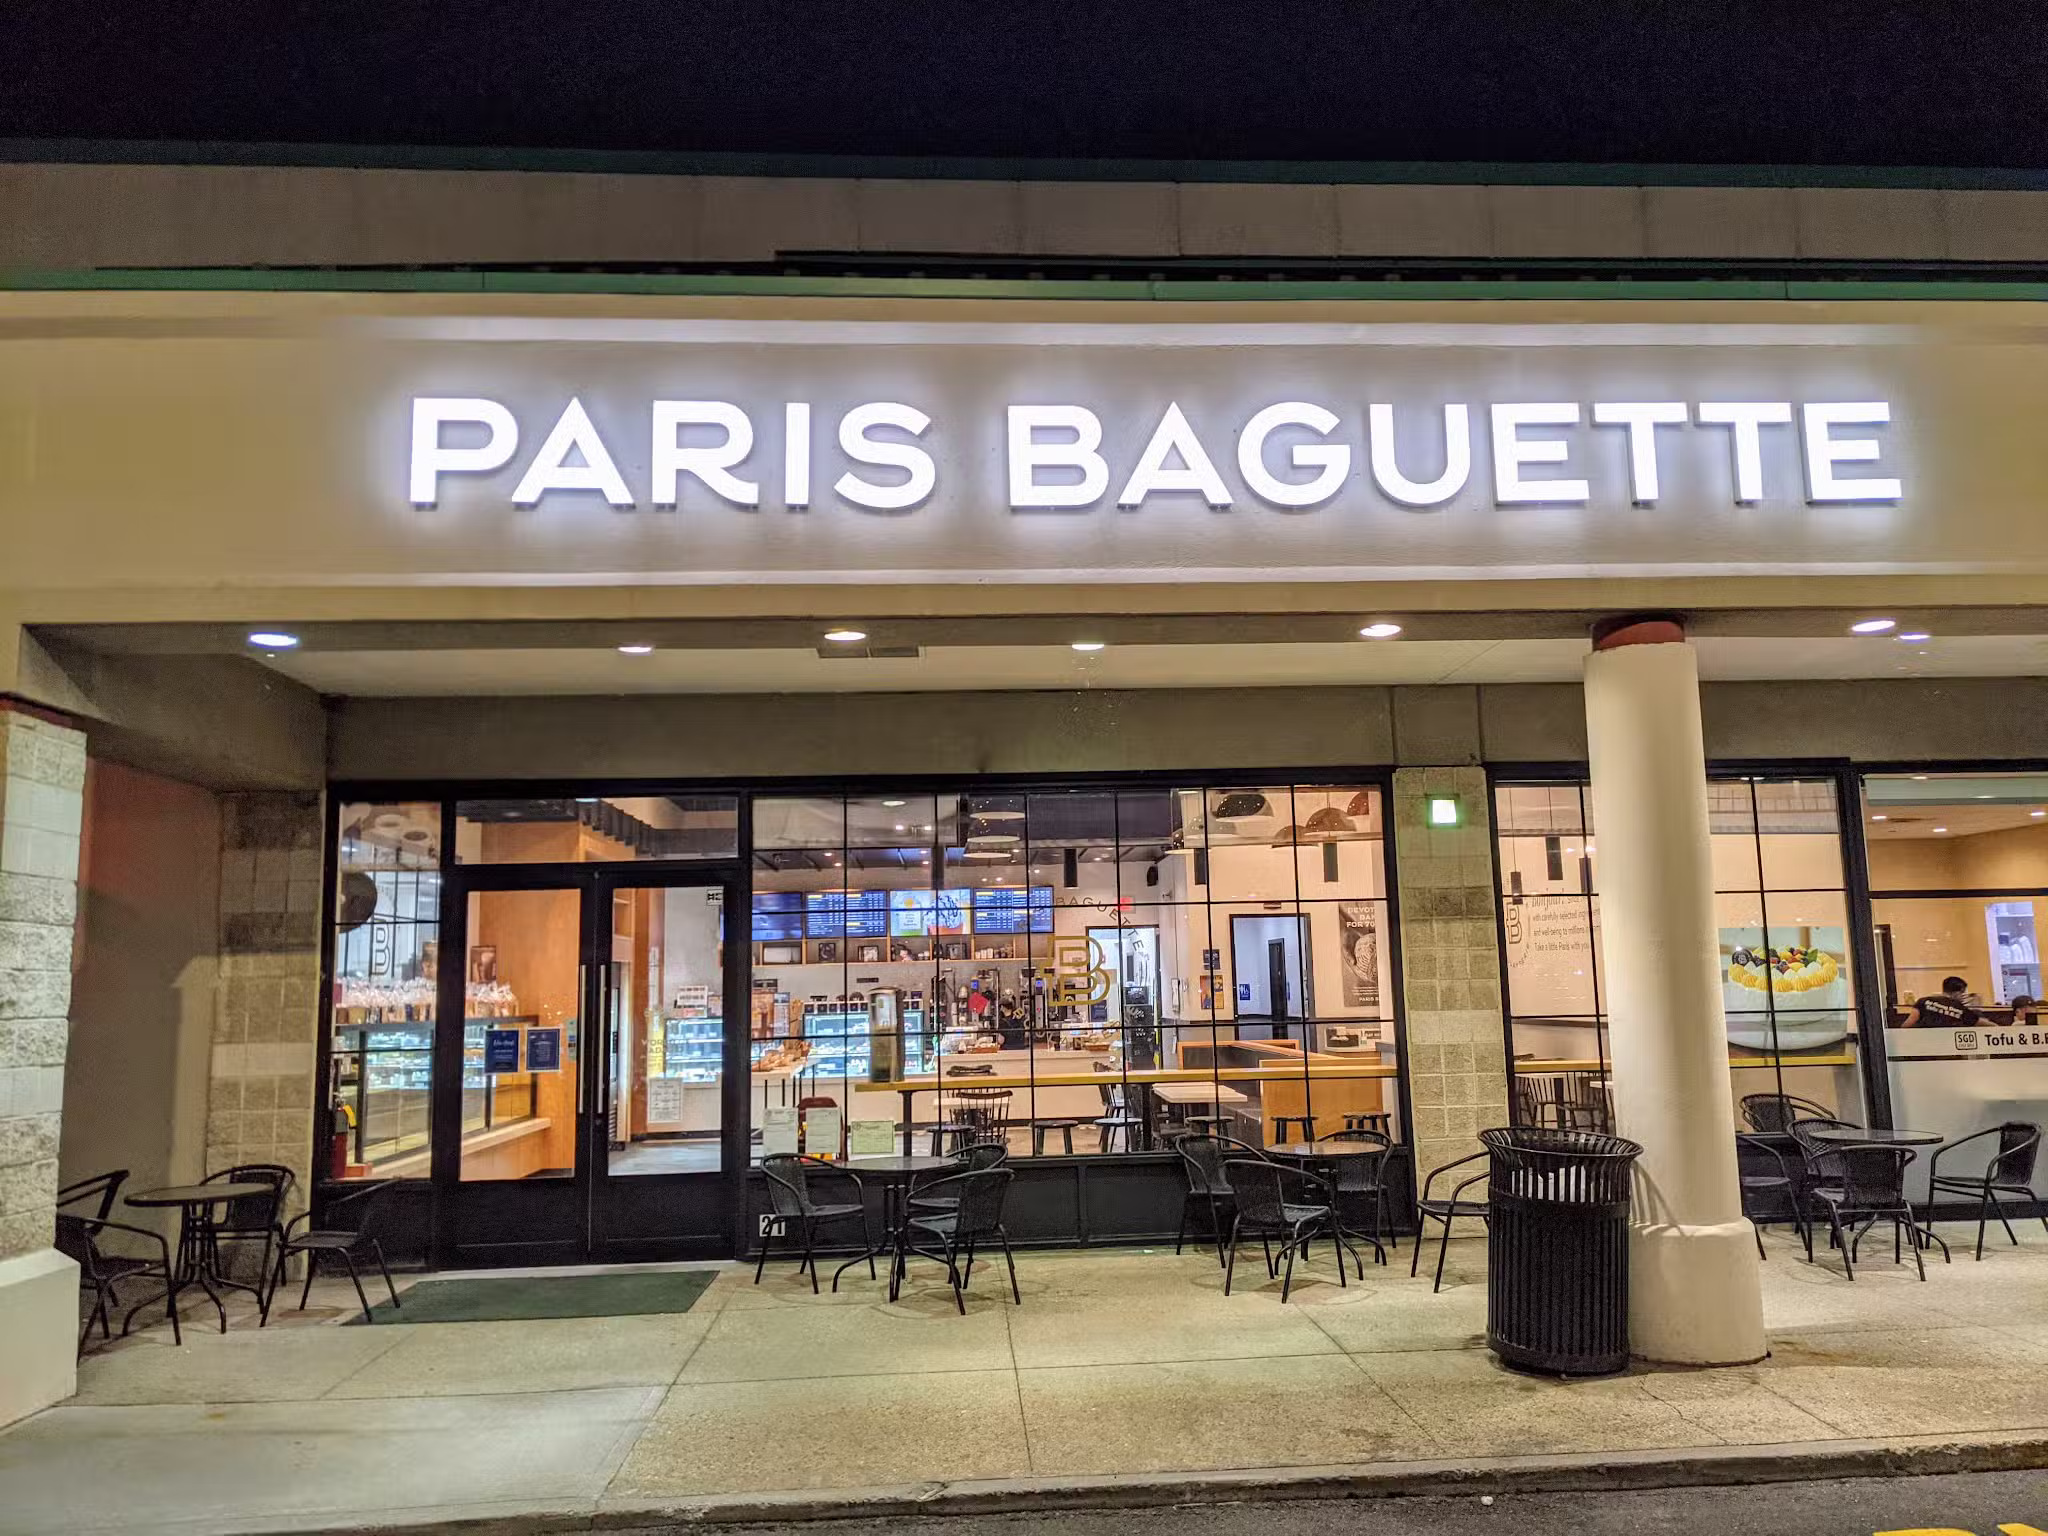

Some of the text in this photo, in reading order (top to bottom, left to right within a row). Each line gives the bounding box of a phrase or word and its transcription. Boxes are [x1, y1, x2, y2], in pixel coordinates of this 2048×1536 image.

[410, 396, 1902, 508] PARIS BAGUETTE
[1056, 895, 1145, 951] BAGUETTE
[1958, 1034, 1975, 1043] SGD
[1984, 1033, 2014, 1046] Tofu
[2018, 1033, 2028, 1045] &
